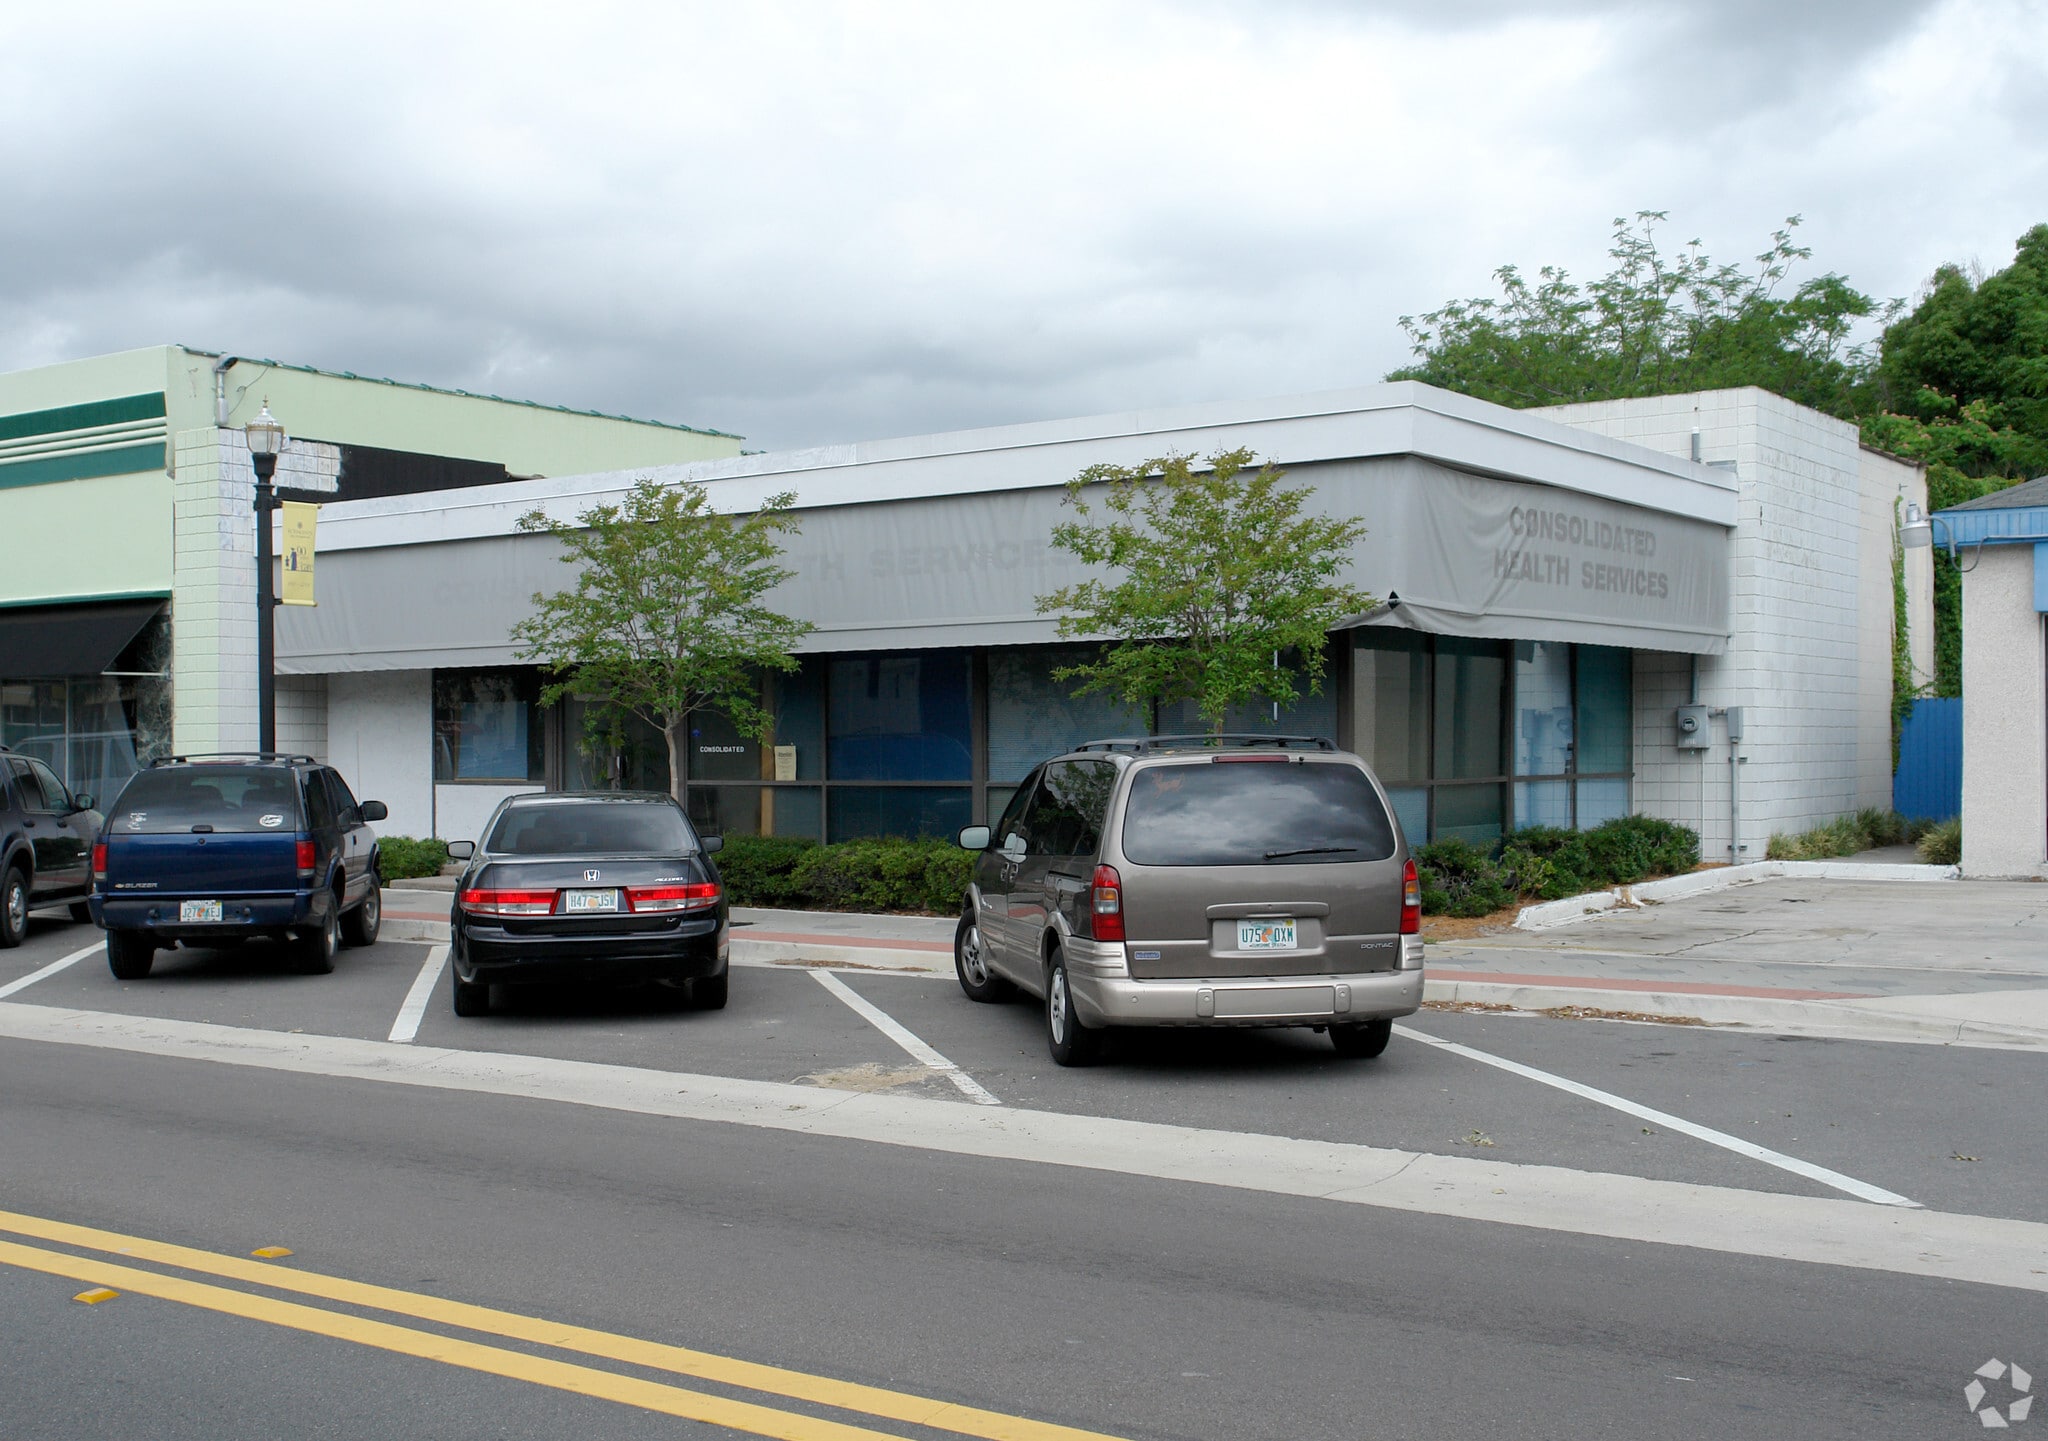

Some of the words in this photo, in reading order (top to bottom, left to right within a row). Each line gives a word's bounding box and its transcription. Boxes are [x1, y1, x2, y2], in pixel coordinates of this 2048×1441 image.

[1509, 506, 1656, 557] CONSOLIDATED
[1493, 548, 1570, 587] HEALTH
[1581, 561, 1669, 600] SERVICES
[570, 895, 587, 907] H47
[1242, 928, 1261, 943] U75
[1360, 941, 1394, 950] PONTIAC
